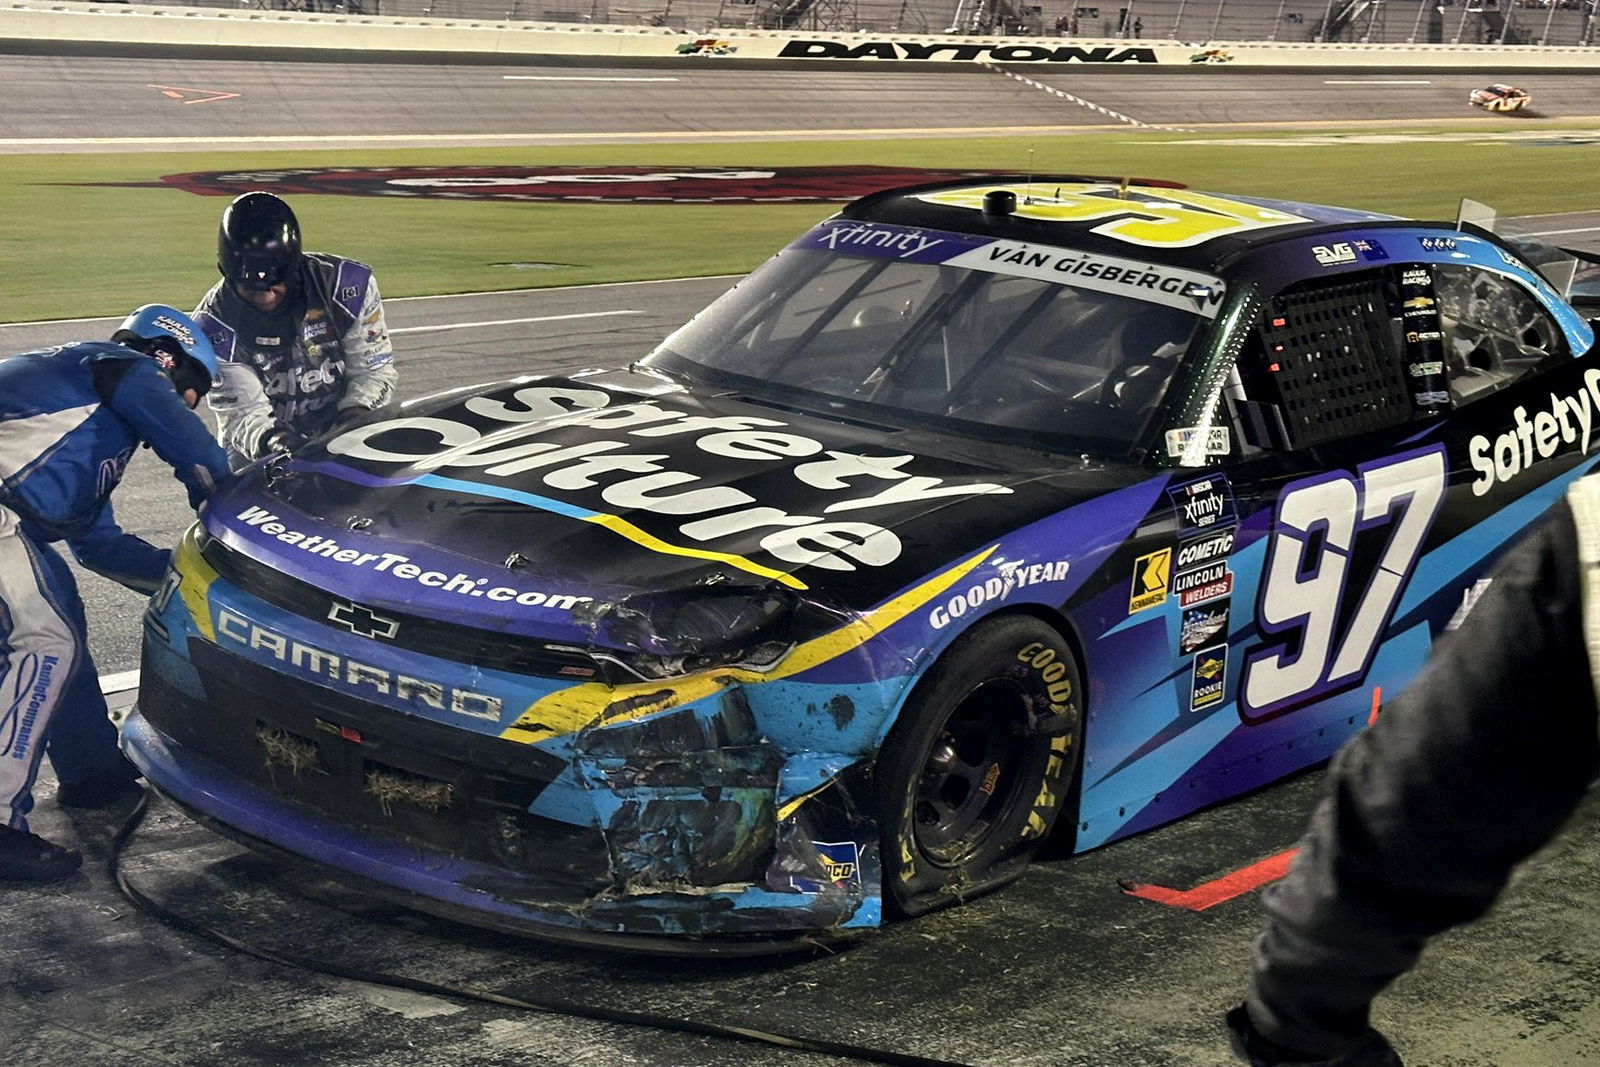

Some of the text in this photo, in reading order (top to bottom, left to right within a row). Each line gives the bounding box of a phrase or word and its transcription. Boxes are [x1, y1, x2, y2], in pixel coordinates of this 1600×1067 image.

[776, 39, 1158, 64] DAYTONA
[816, 221, 945, 258] xfinity
[1311, 242, 1356, 264] SVG
[987, 244, 1225, 309] VAN GISBERGEN
[1184, 492, 1224, 524] xfinity
[1177, 534, 1234, 566] COMETIC
[1175, 565, 1224, 592] LINCOLN
[1184, 581, 1228, 604] WELDERS
[1243, 449, 1446, 712] 97
[217, 609, 502, 722] CAMARO
[1193, 681, 1223, 699] ROOKIE
[11, 654, 59, 761] KauligCompanies
